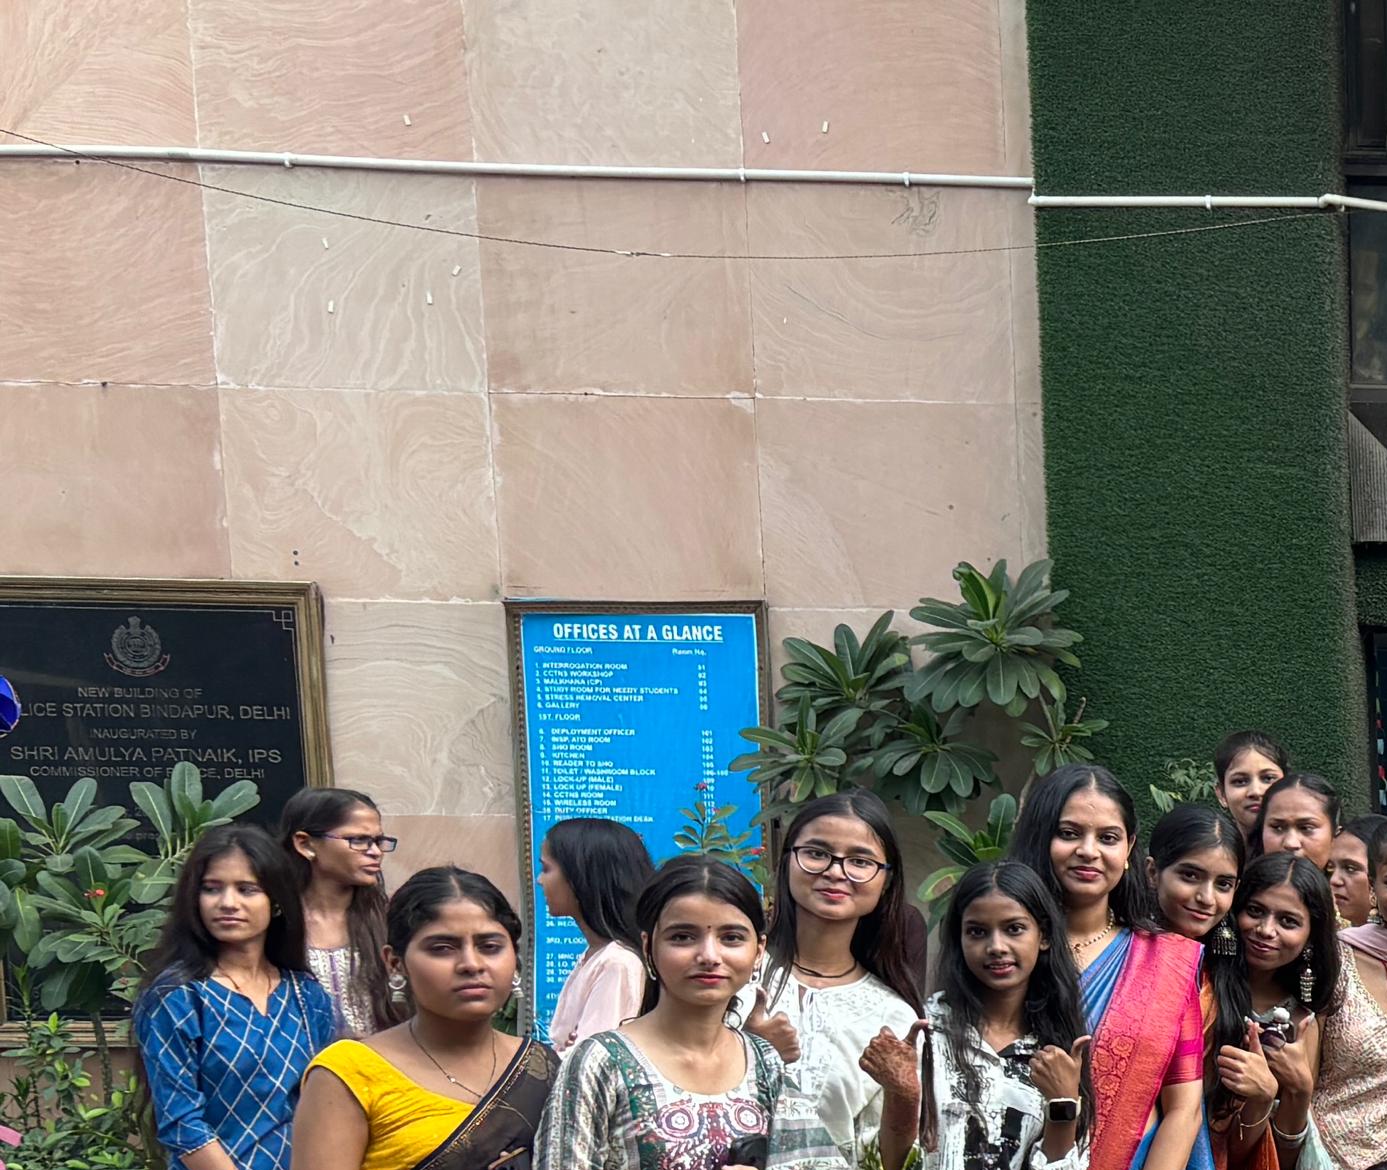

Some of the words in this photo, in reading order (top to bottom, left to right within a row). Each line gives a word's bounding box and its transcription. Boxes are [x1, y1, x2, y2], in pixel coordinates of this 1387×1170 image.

[553, 623, 619, 640] OFFICES
[623, 624, 642, 640] AT
[647, 625, 658, 640] A
[662, 625, 723, 641] GLANCE
[534, 646, 566, 654] GROUND
[567, 646, 593, 655] FLOOR
[543, 662, 603, 670] INTERROGATION
[570, 671, 614, 679] WORKSHOP
[78, 687, 109, 698] NEW
[113, 687, 179, 699] BUILDING
[183, 688, 203, 699] OF
[20, 702, 57, 717] LICE
[62, 703, 135, 718] STATION
[141, 704, 235, 720] BINDAPUR,
[240, 705, 290, 720] DELHI
[555, 713, 581, 721] FLOOR
[90, 728, 177, 740] INAUGURATED
[180, 729, 198, 740] BY
[551, 728, 602, 736] DEPLOYMENT
[10, 745, 59, 761] SHRI
[64, 746, 148, 761] AMULYA
[152, 747, 242, 764] PATNAIK,
[248, 749, 282, 763] IPS
[552, 752, 585, 760] KITCHEN
[30, 766, 140, 777] COMMISSIONER
[143, 767, 163, 778] OF
[224, 767, 265, 779] DELHI
[584, 768, 628, 776] WASHROOM
[588, 776, 614, 784] (MALE)
[588, 784, 623, 792] (FEMALE)
[554, 807, 575, 815] DUTY
